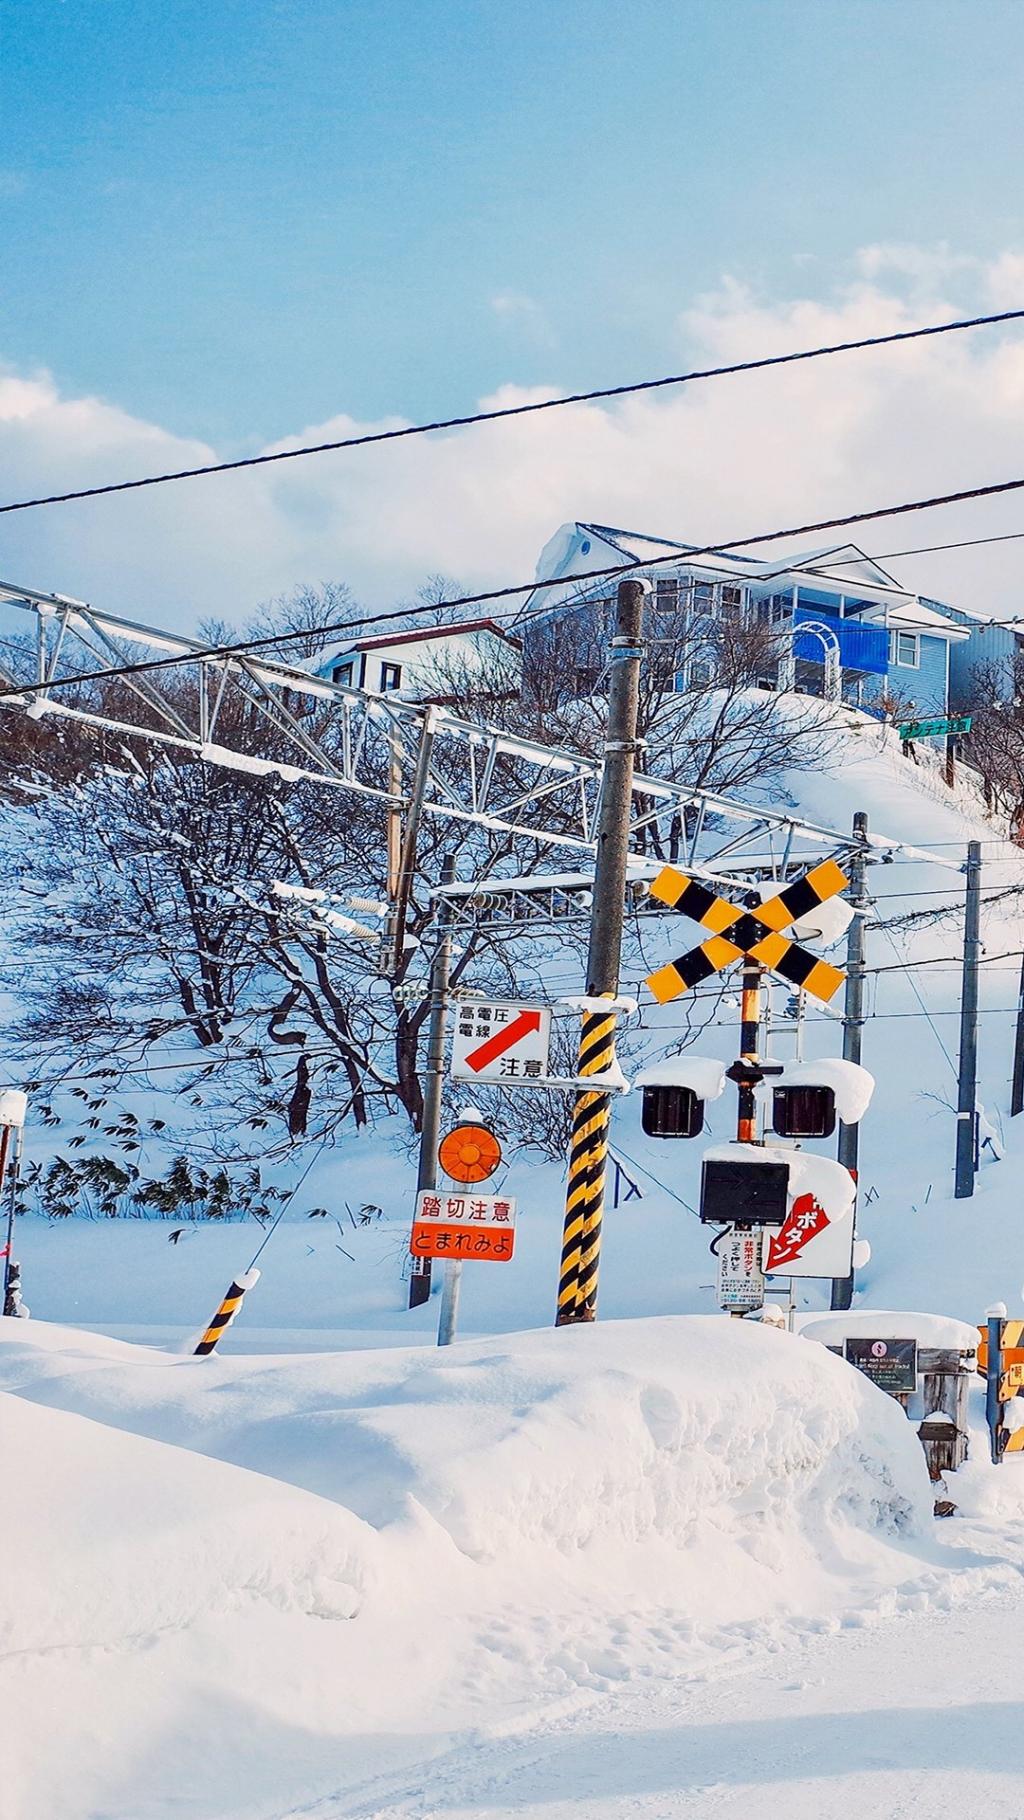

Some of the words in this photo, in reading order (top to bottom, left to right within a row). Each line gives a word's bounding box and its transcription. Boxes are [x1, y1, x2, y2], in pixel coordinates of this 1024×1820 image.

[460, 1006, 509, 1023] 高電圧
[459, 1023, 490, 1038] 電線
[500, 1057, 543, 1078] 注意
[421, 1196, 510, 1222] 踏切注意
[415, 1230, 510, 1254] とまれみよ
[773, 1202, 822, 1260] ボタン
